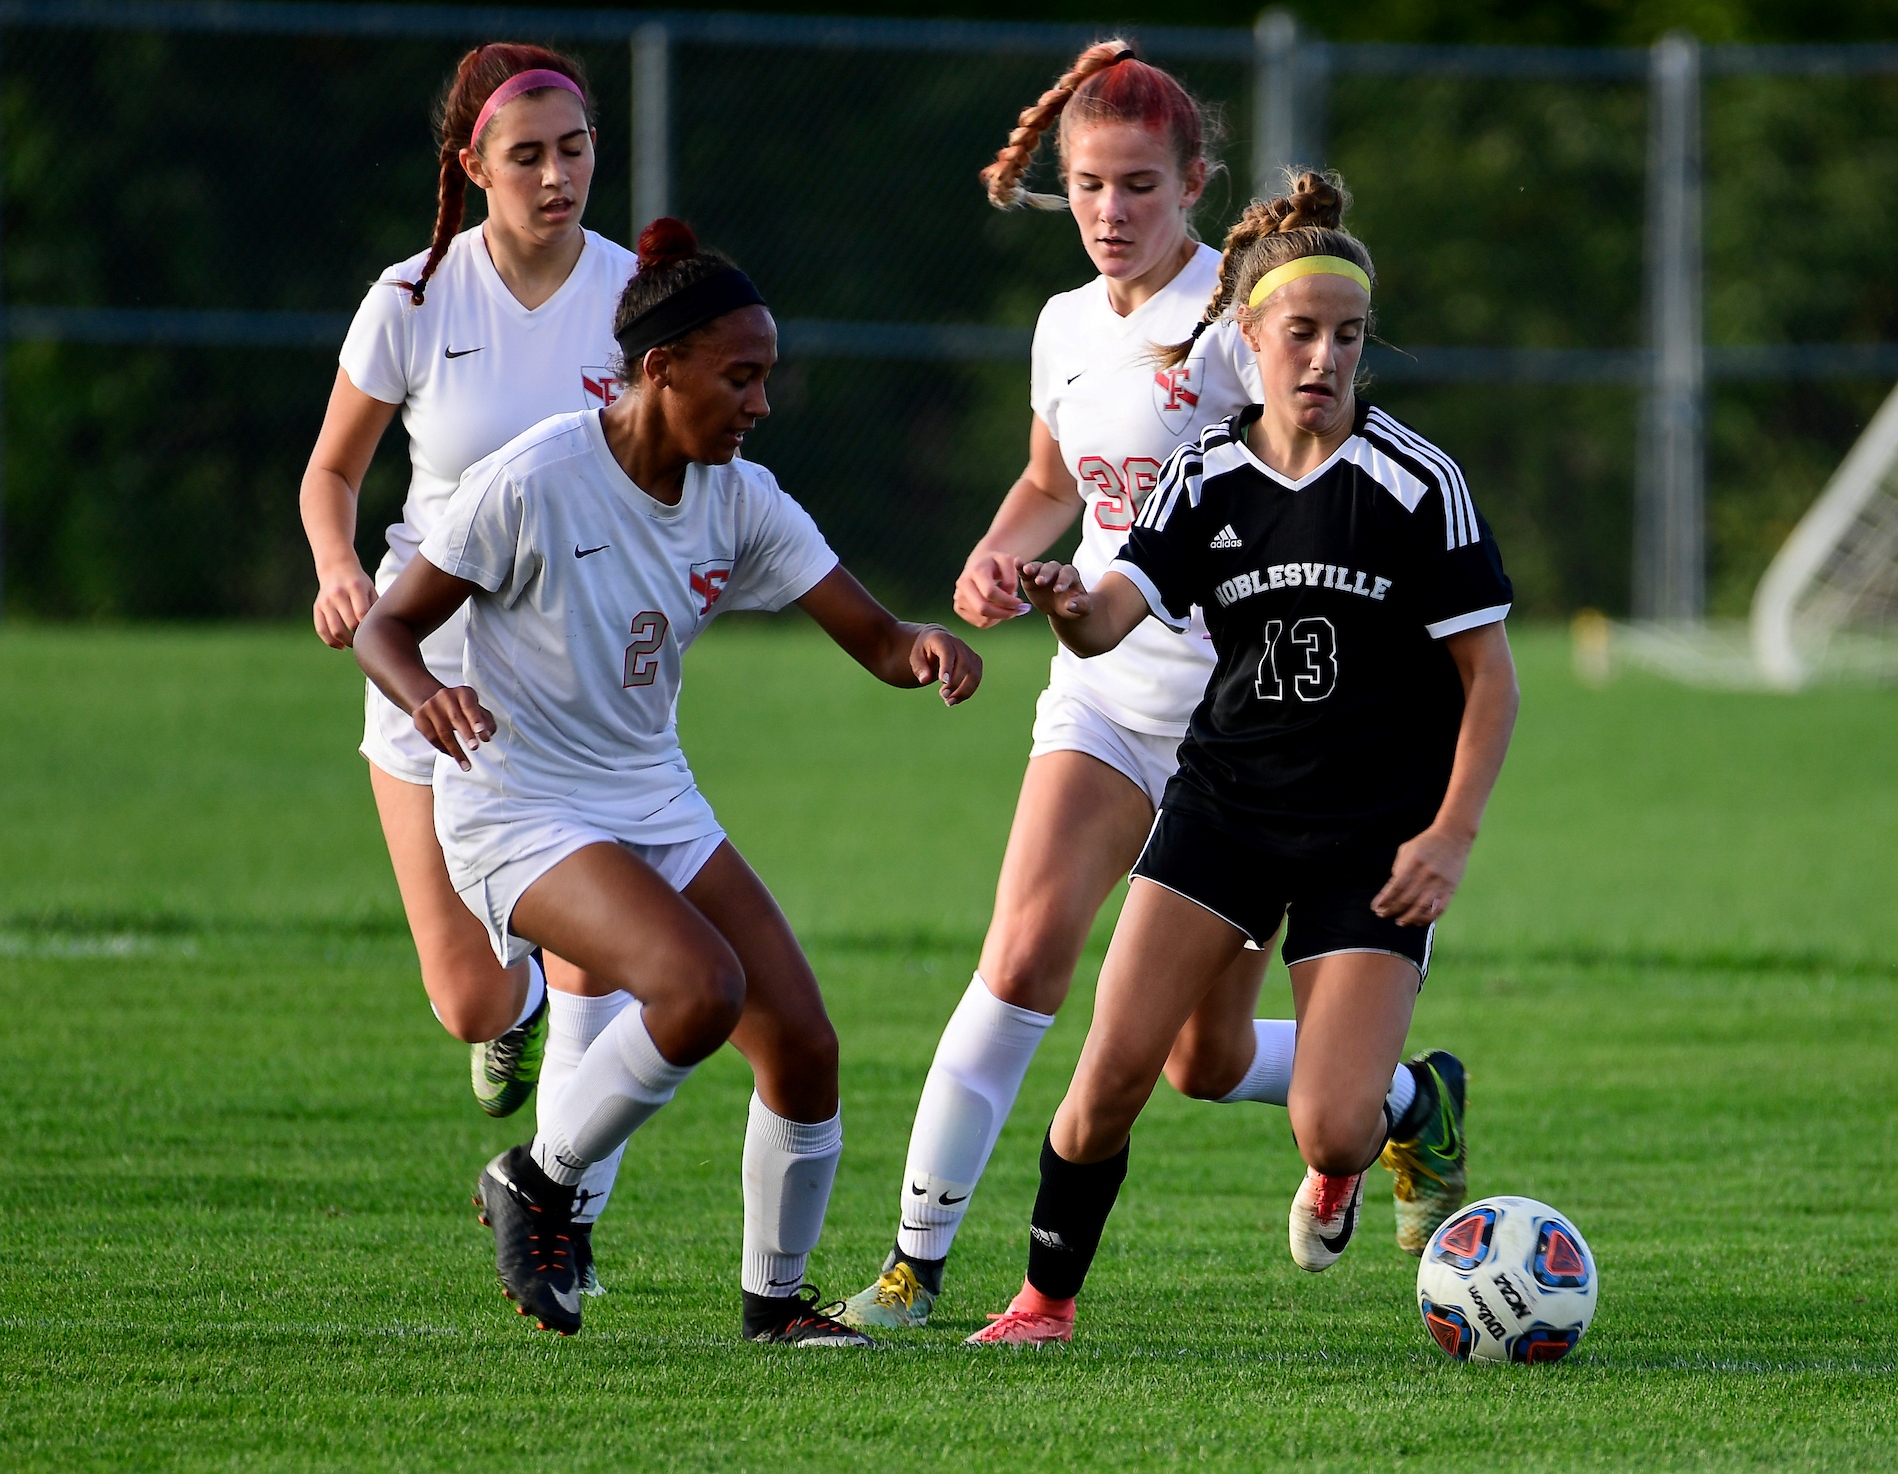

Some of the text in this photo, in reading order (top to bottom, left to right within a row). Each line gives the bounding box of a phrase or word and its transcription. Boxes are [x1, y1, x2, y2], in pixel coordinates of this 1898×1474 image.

[1210, 539, 1242, 549] adidas
[1214, 563, 1392, 608] NOBLESVILLE
[623, 611, 669, 688] 2
[1255, 617, 1338, 701] 13
[1468, 1284, 1507, 1341] Wilson
[1493, 1273, 1532, 1319] NCAA
